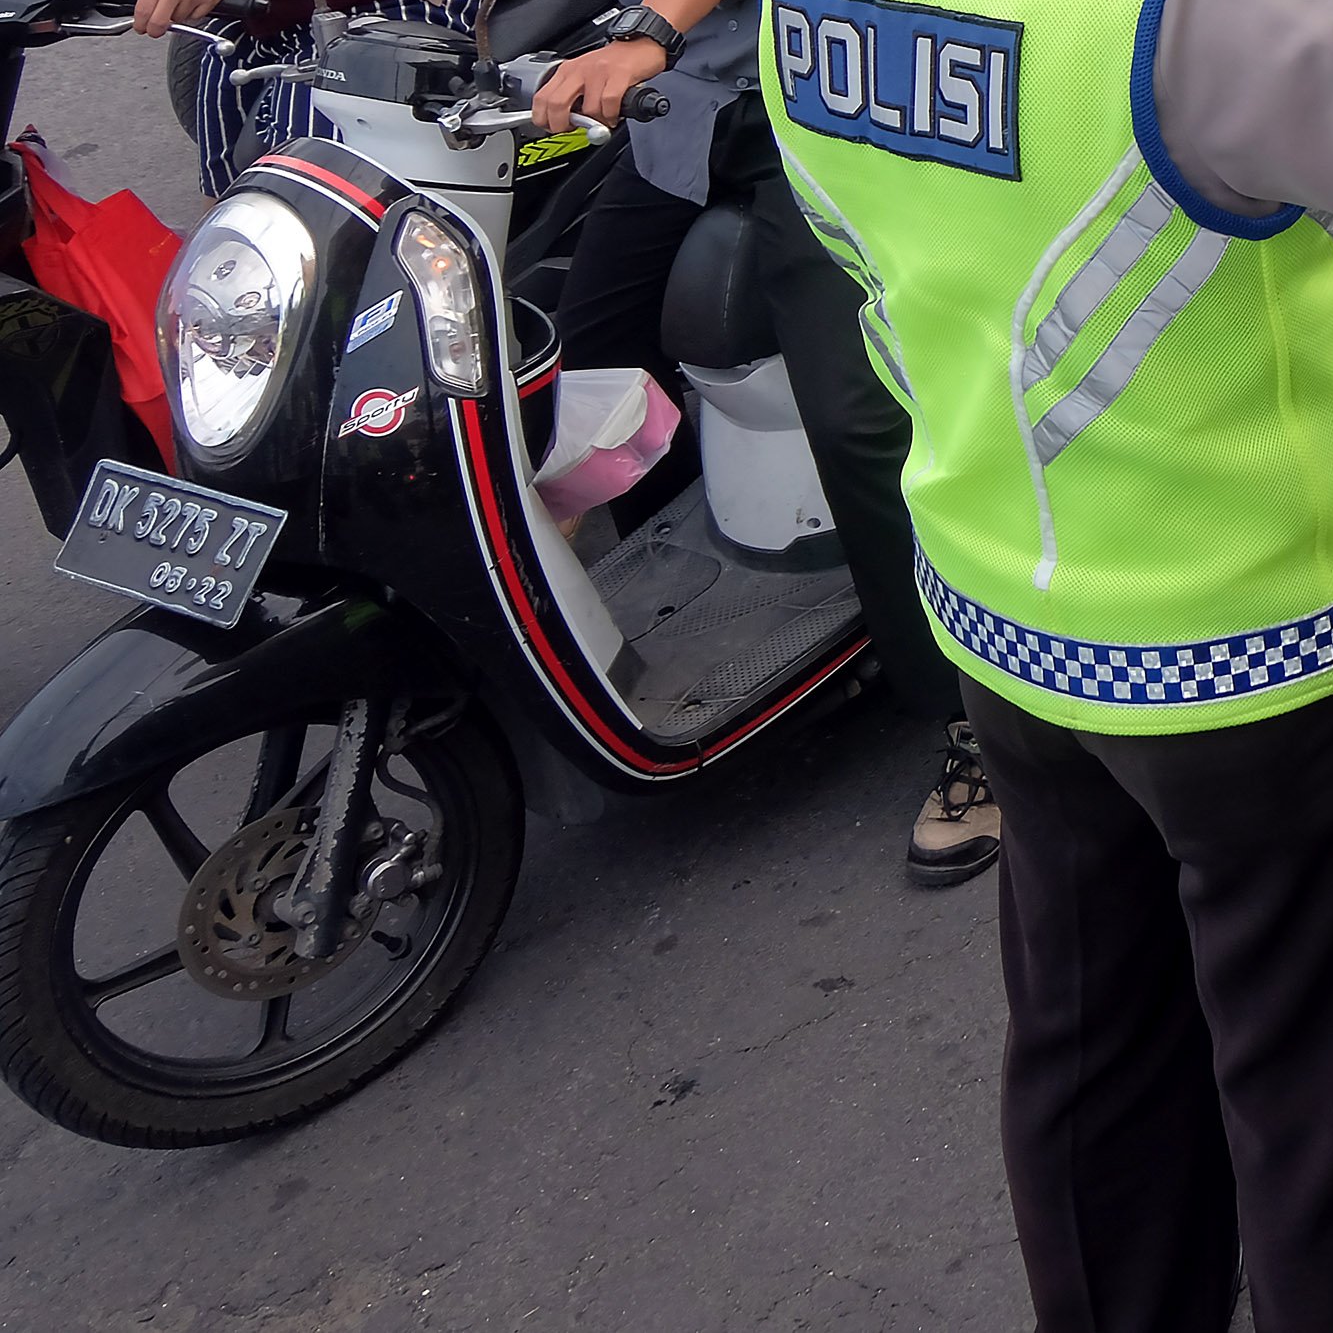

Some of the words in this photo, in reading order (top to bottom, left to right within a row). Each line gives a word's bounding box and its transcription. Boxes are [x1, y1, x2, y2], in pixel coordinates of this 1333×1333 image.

[778, 6, 1006, 149] POLISI
[88, 478, 140, 534] DK
[134, 492, 219, 555] 5275
[213, 516, 268, 570] ZT
